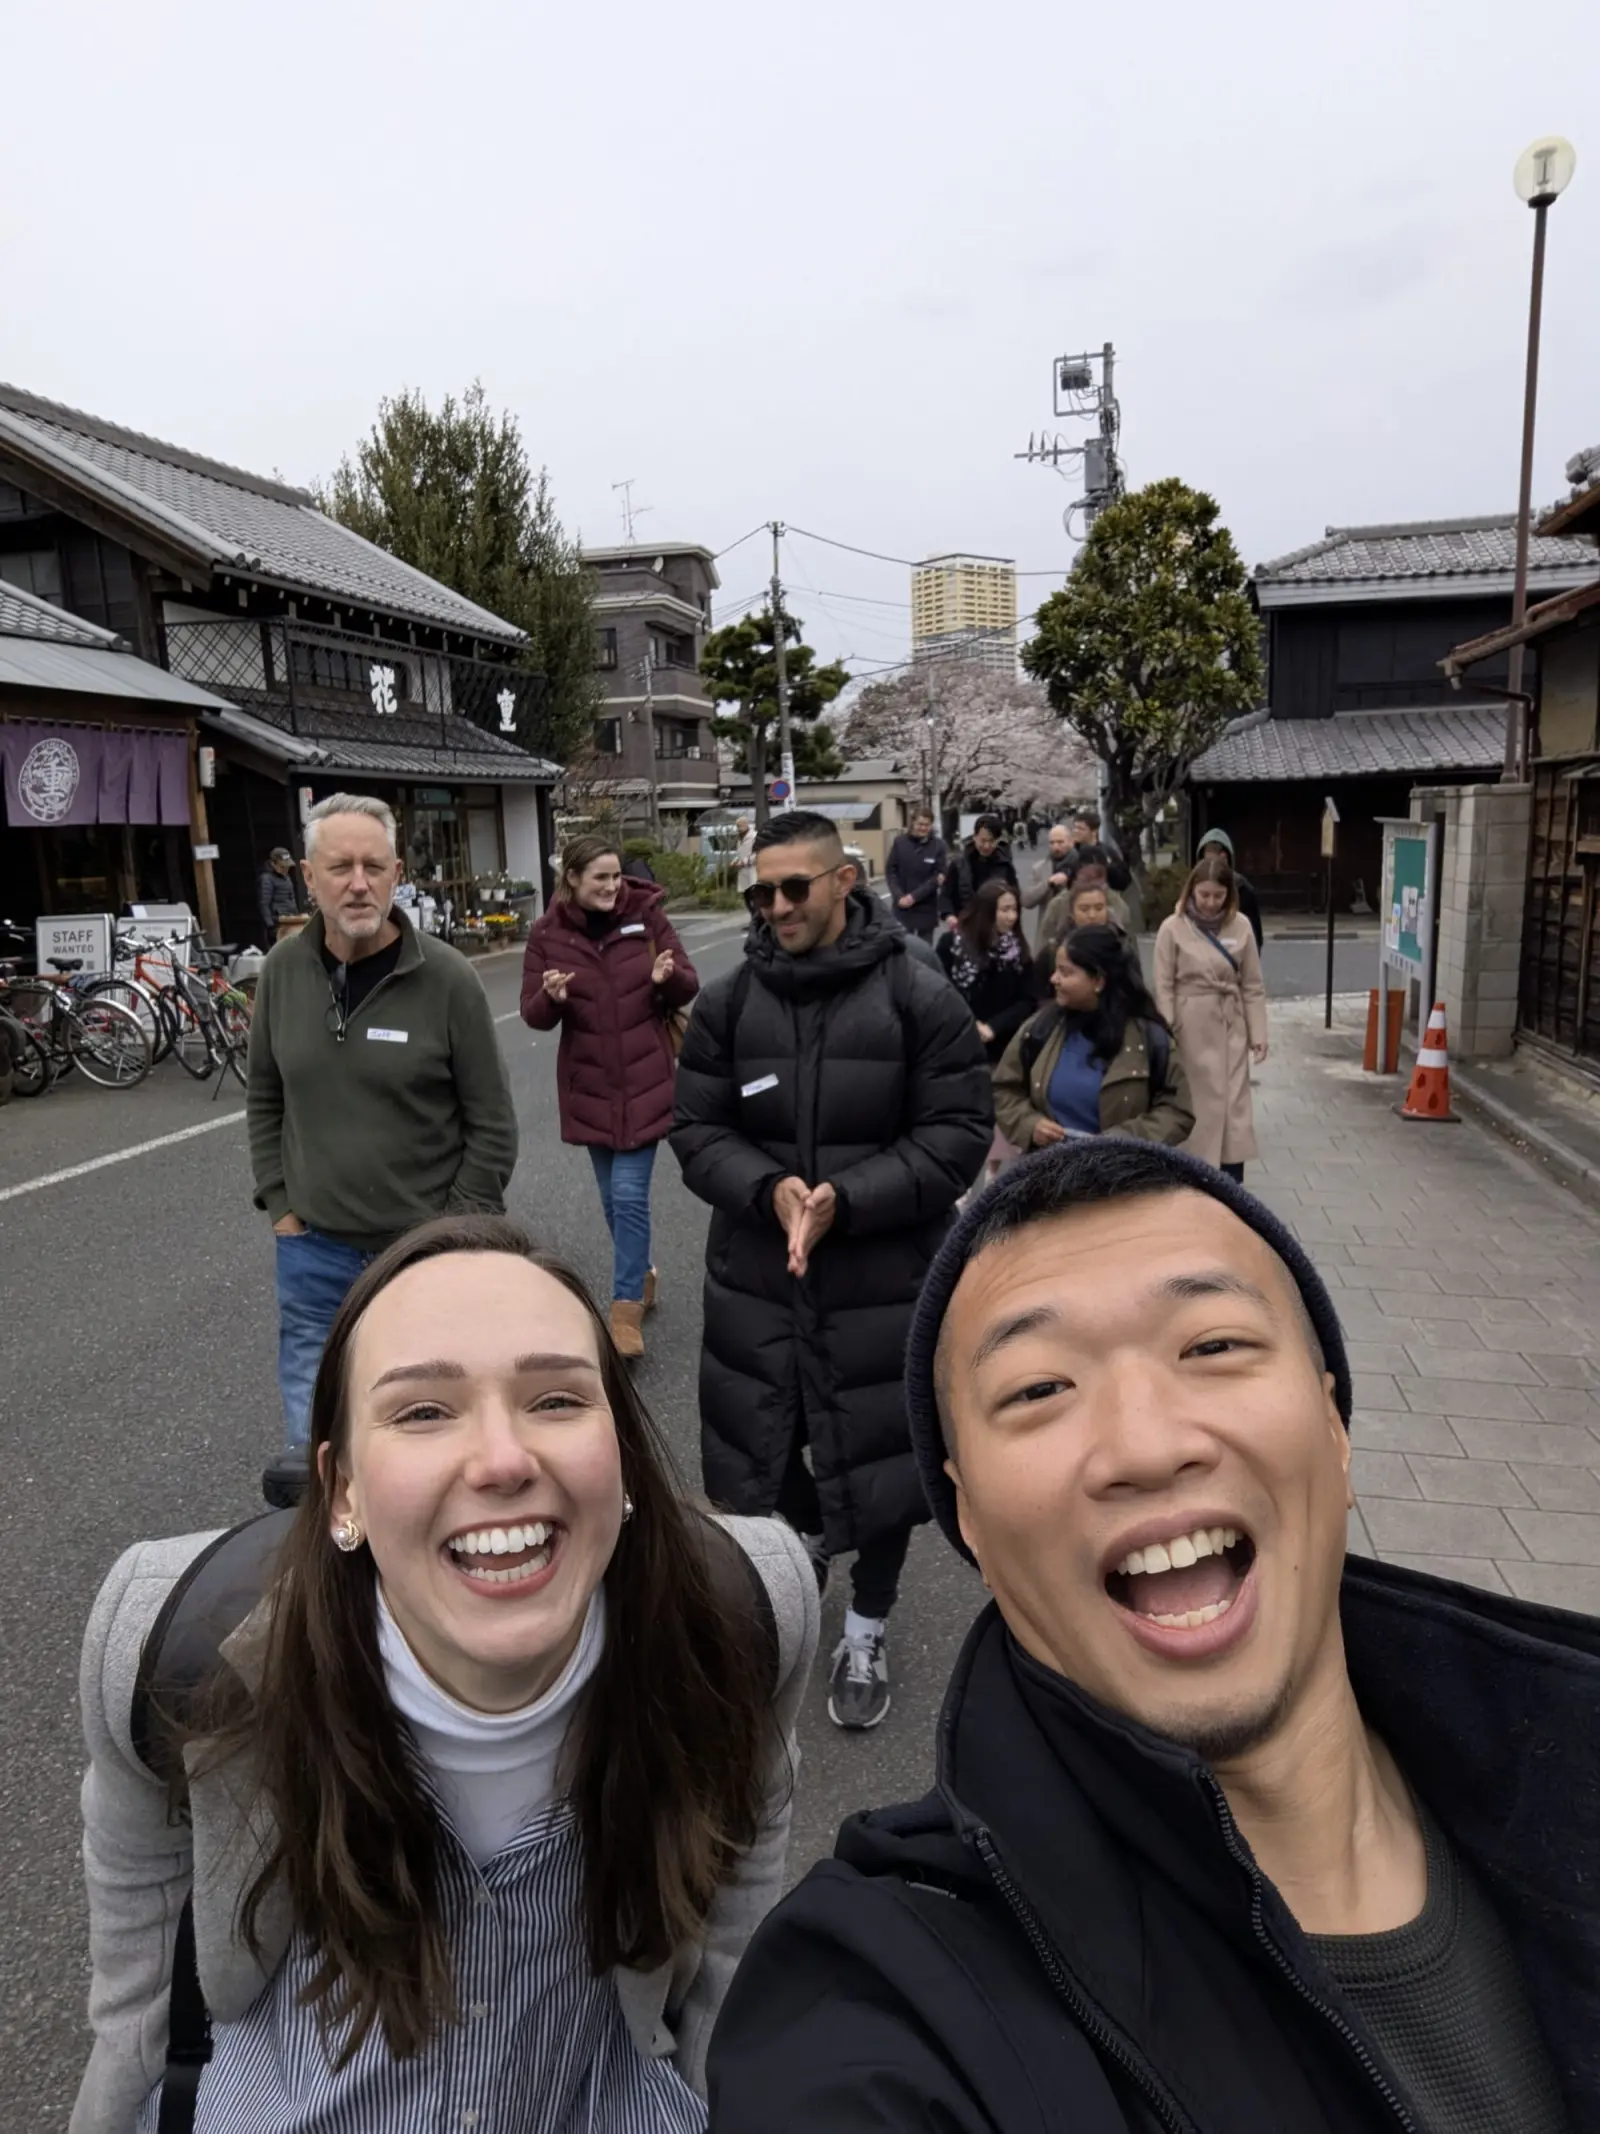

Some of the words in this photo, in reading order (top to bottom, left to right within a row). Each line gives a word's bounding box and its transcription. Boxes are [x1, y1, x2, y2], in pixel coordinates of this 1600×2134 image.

[369, 664, 398, 714] 花
[52, 929, 94, 943] STAFF
[52, 944, 94, 954] WANTED
